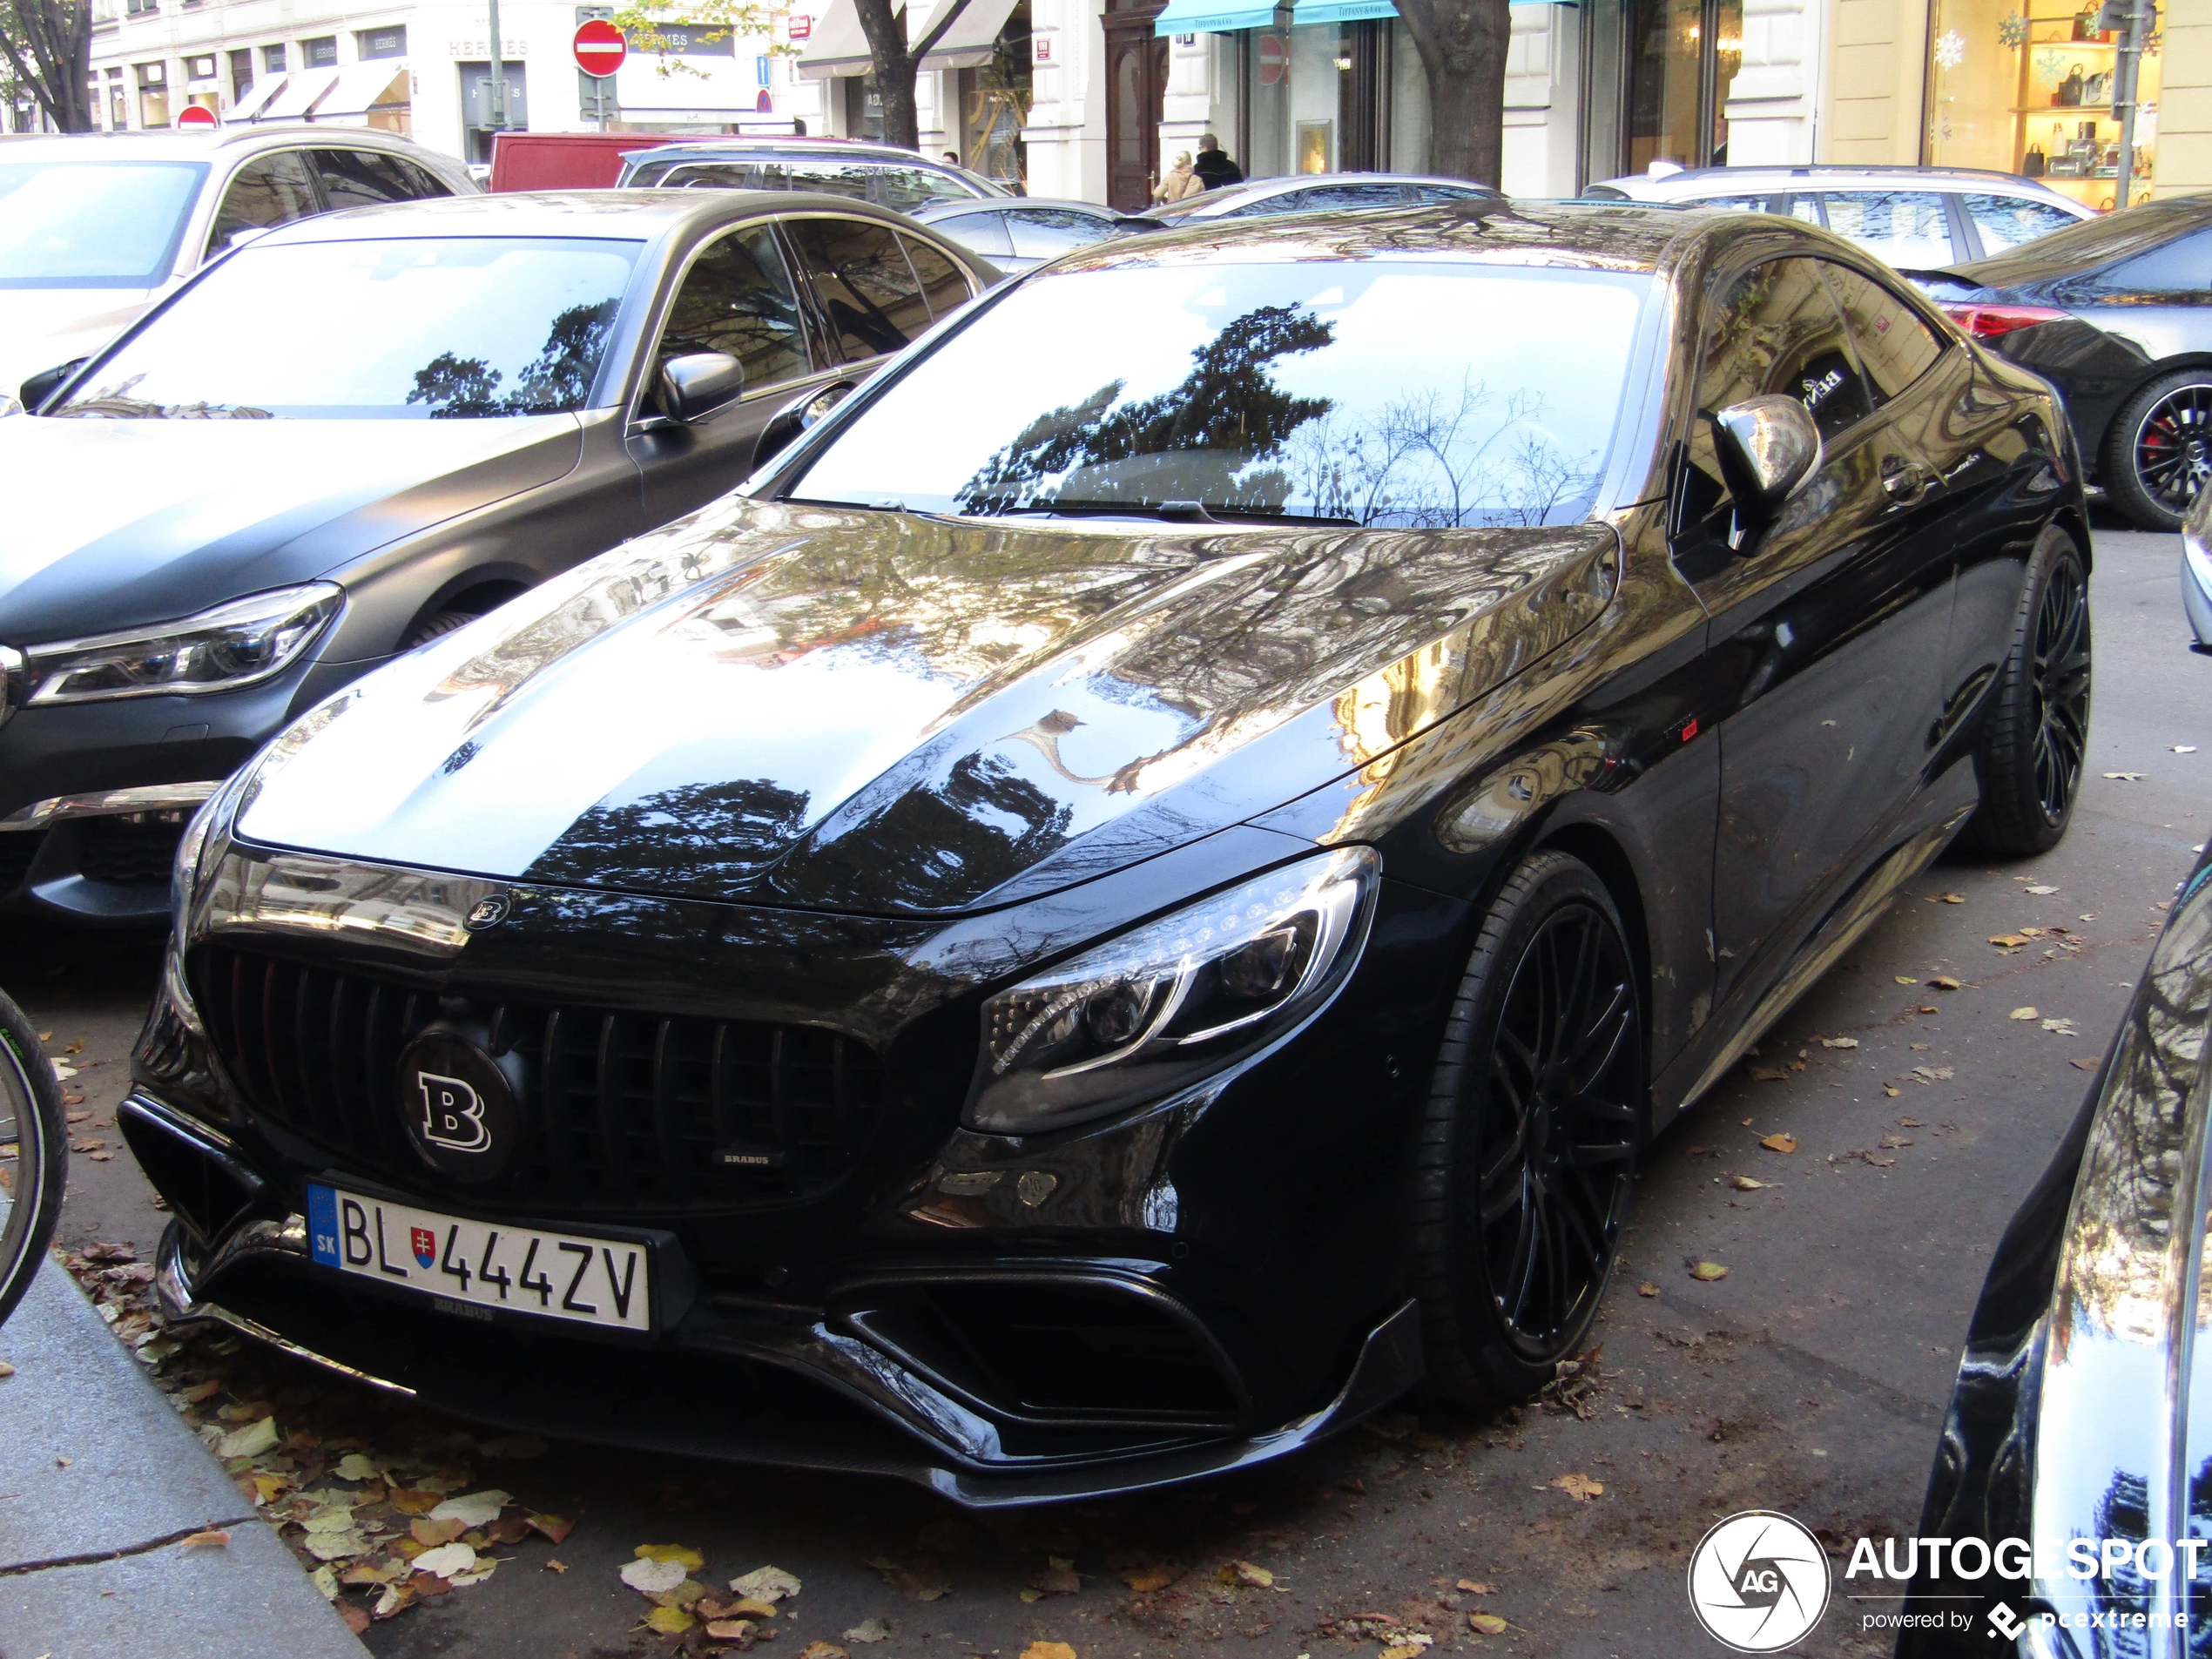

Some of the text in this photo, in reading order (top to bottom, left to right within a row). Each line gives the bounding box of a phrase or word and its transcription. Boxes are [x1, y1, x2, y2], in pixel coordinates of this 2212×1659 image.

[448, 38, 529, 55] HERÈS
[469, 900, 502, 922] B
[418, 1070, 492, 1153] B
[725, 1155, 769, 1164] BRABUS
[317, 1233, 336, 1255] SK
[342, 1197, 637, 1318] BL 444ZV
[434, 1297, 494, 1321] BRABUS
